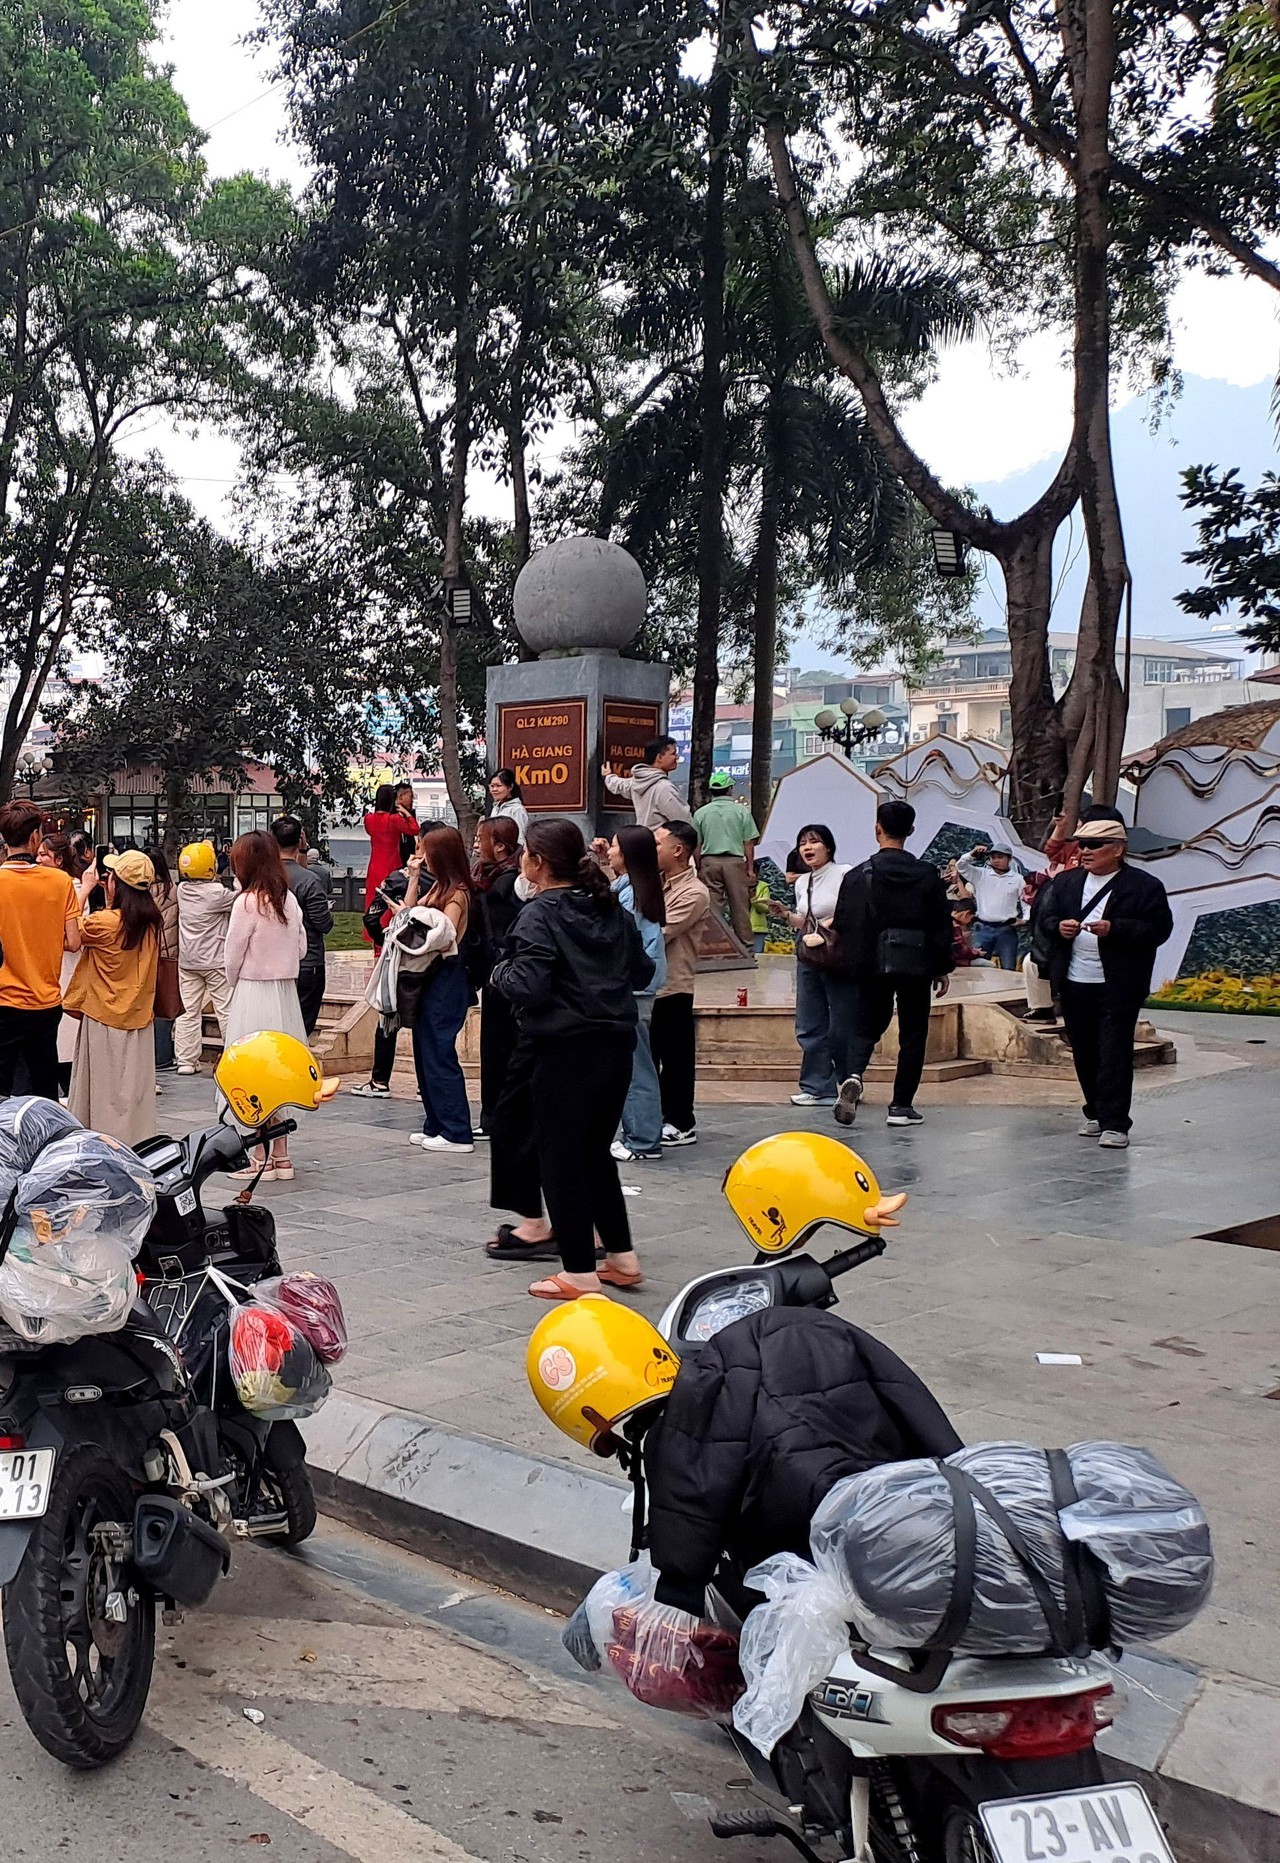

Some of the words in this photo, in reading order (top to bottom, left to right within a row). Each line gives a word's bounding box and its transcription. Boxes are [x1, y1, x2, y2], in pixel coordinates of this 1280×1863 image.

[516, 718, 536, 729] QL2
[537, 715, 569, 727] KM290
[511, 744, 530, 759] HÀ
[532, 745, 573, 758] GIANG
[624, 746, 645, 757] GIAN
[1010, 1795, 1132, 1861] 23-AV
